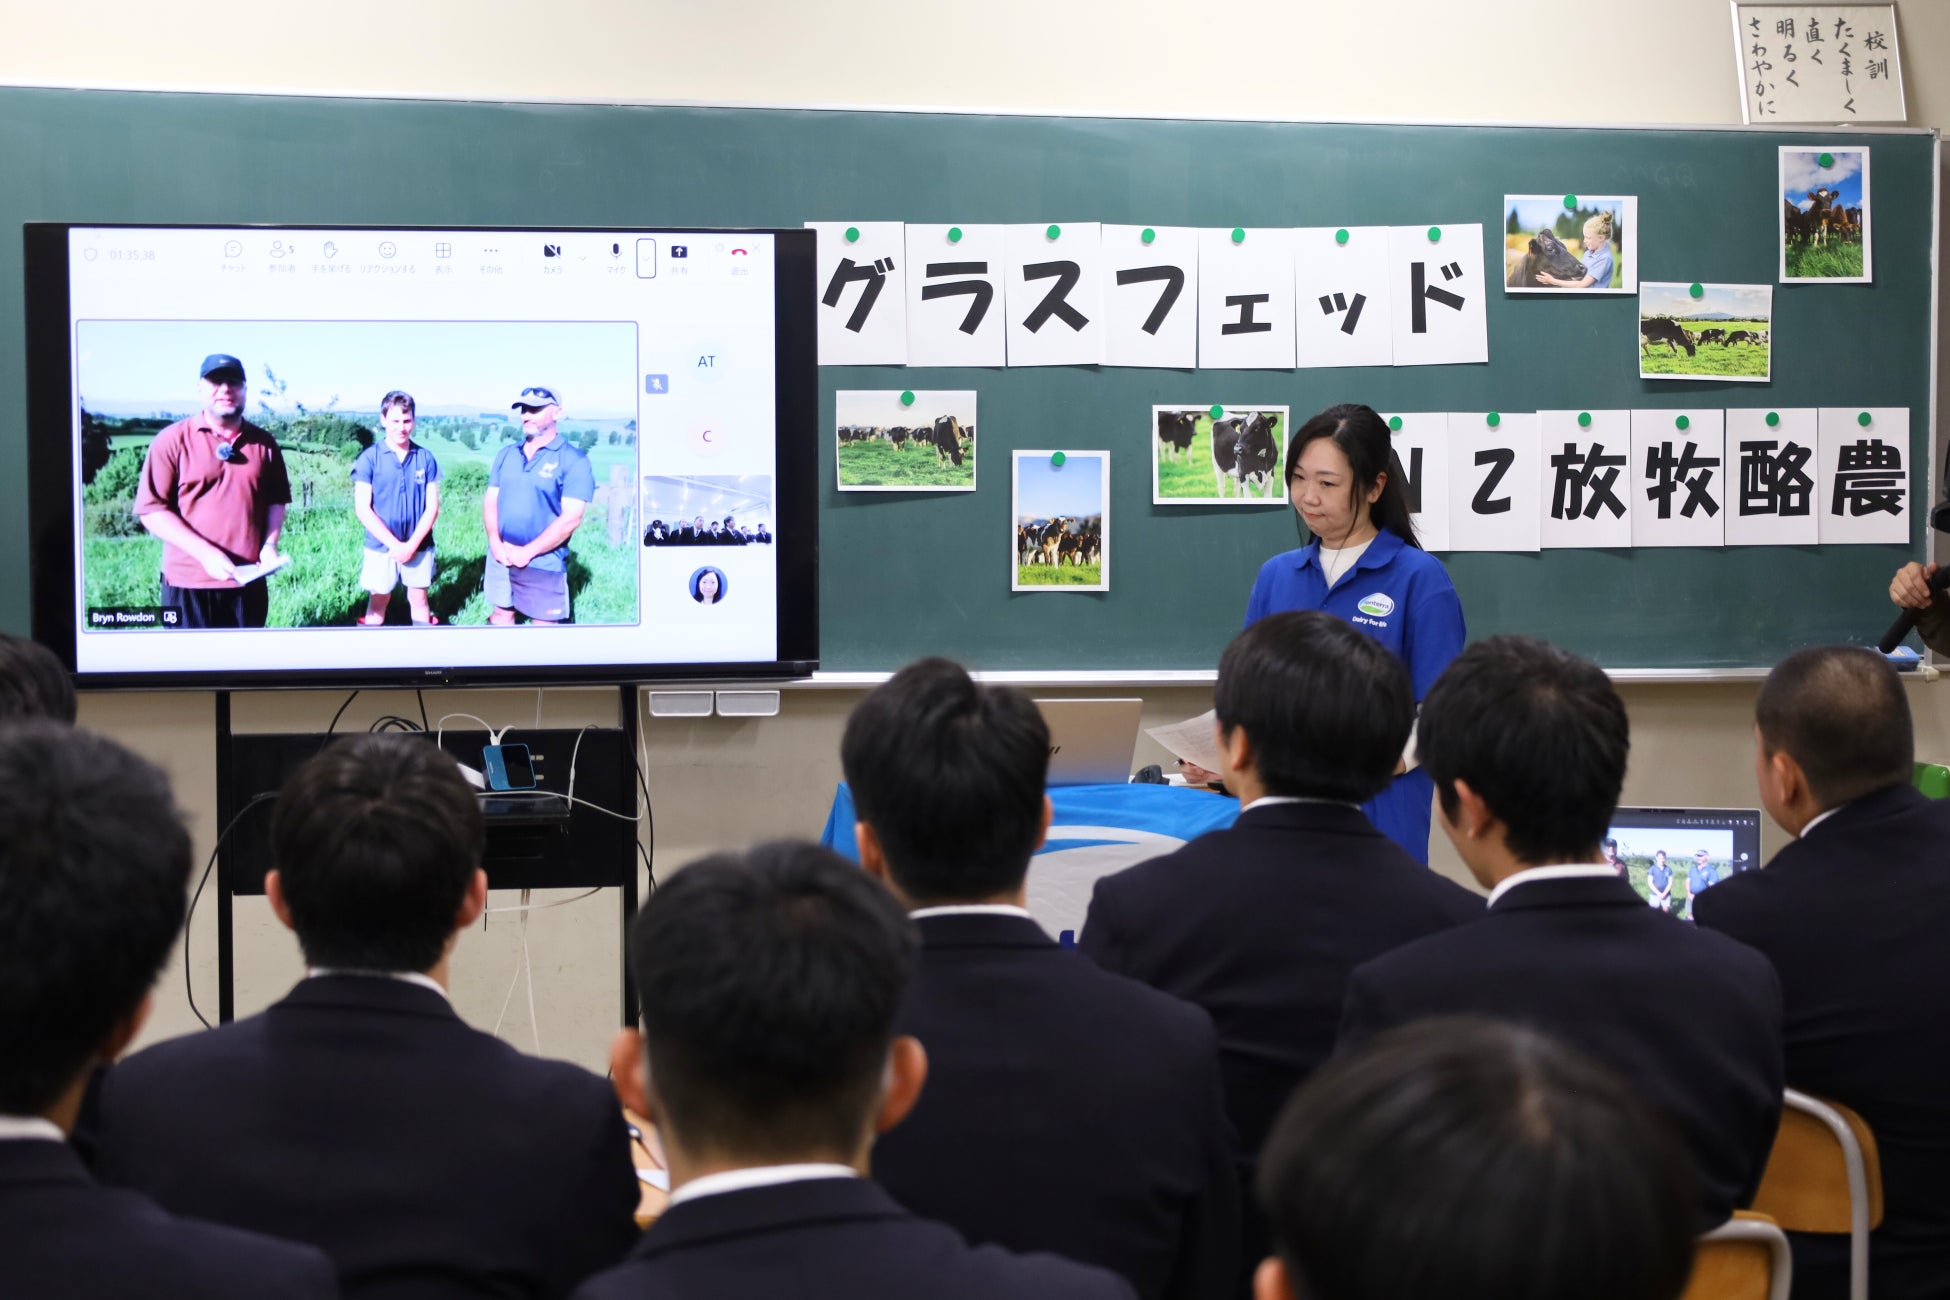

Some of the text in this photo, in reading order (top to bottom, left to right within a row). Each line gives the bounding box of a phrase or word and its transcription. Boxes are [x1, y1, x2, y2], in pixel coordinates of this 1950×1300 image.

[1806, 17, 1825, 65] 直く
[1776, 18, 1799, 87] 明るく
[1864, 31, 1889, 80] 校訓
[1749, 17, 1776, 115] さわやかに
[1834, 17, 1856, 114] たくましく
[288, 245, 294, 254] 5
[543, 265, 563, 275] カメラ
[607, 266, 626, 275] マイク
[822, 257, 1465, 335] グラスフェッド
[698, 355, 716, 367] AT
[702, 430, 712, 442] C
[92, 612, 155, 624] Bryn Rowdon
[1352, 616, 1368, 624] Dairy
